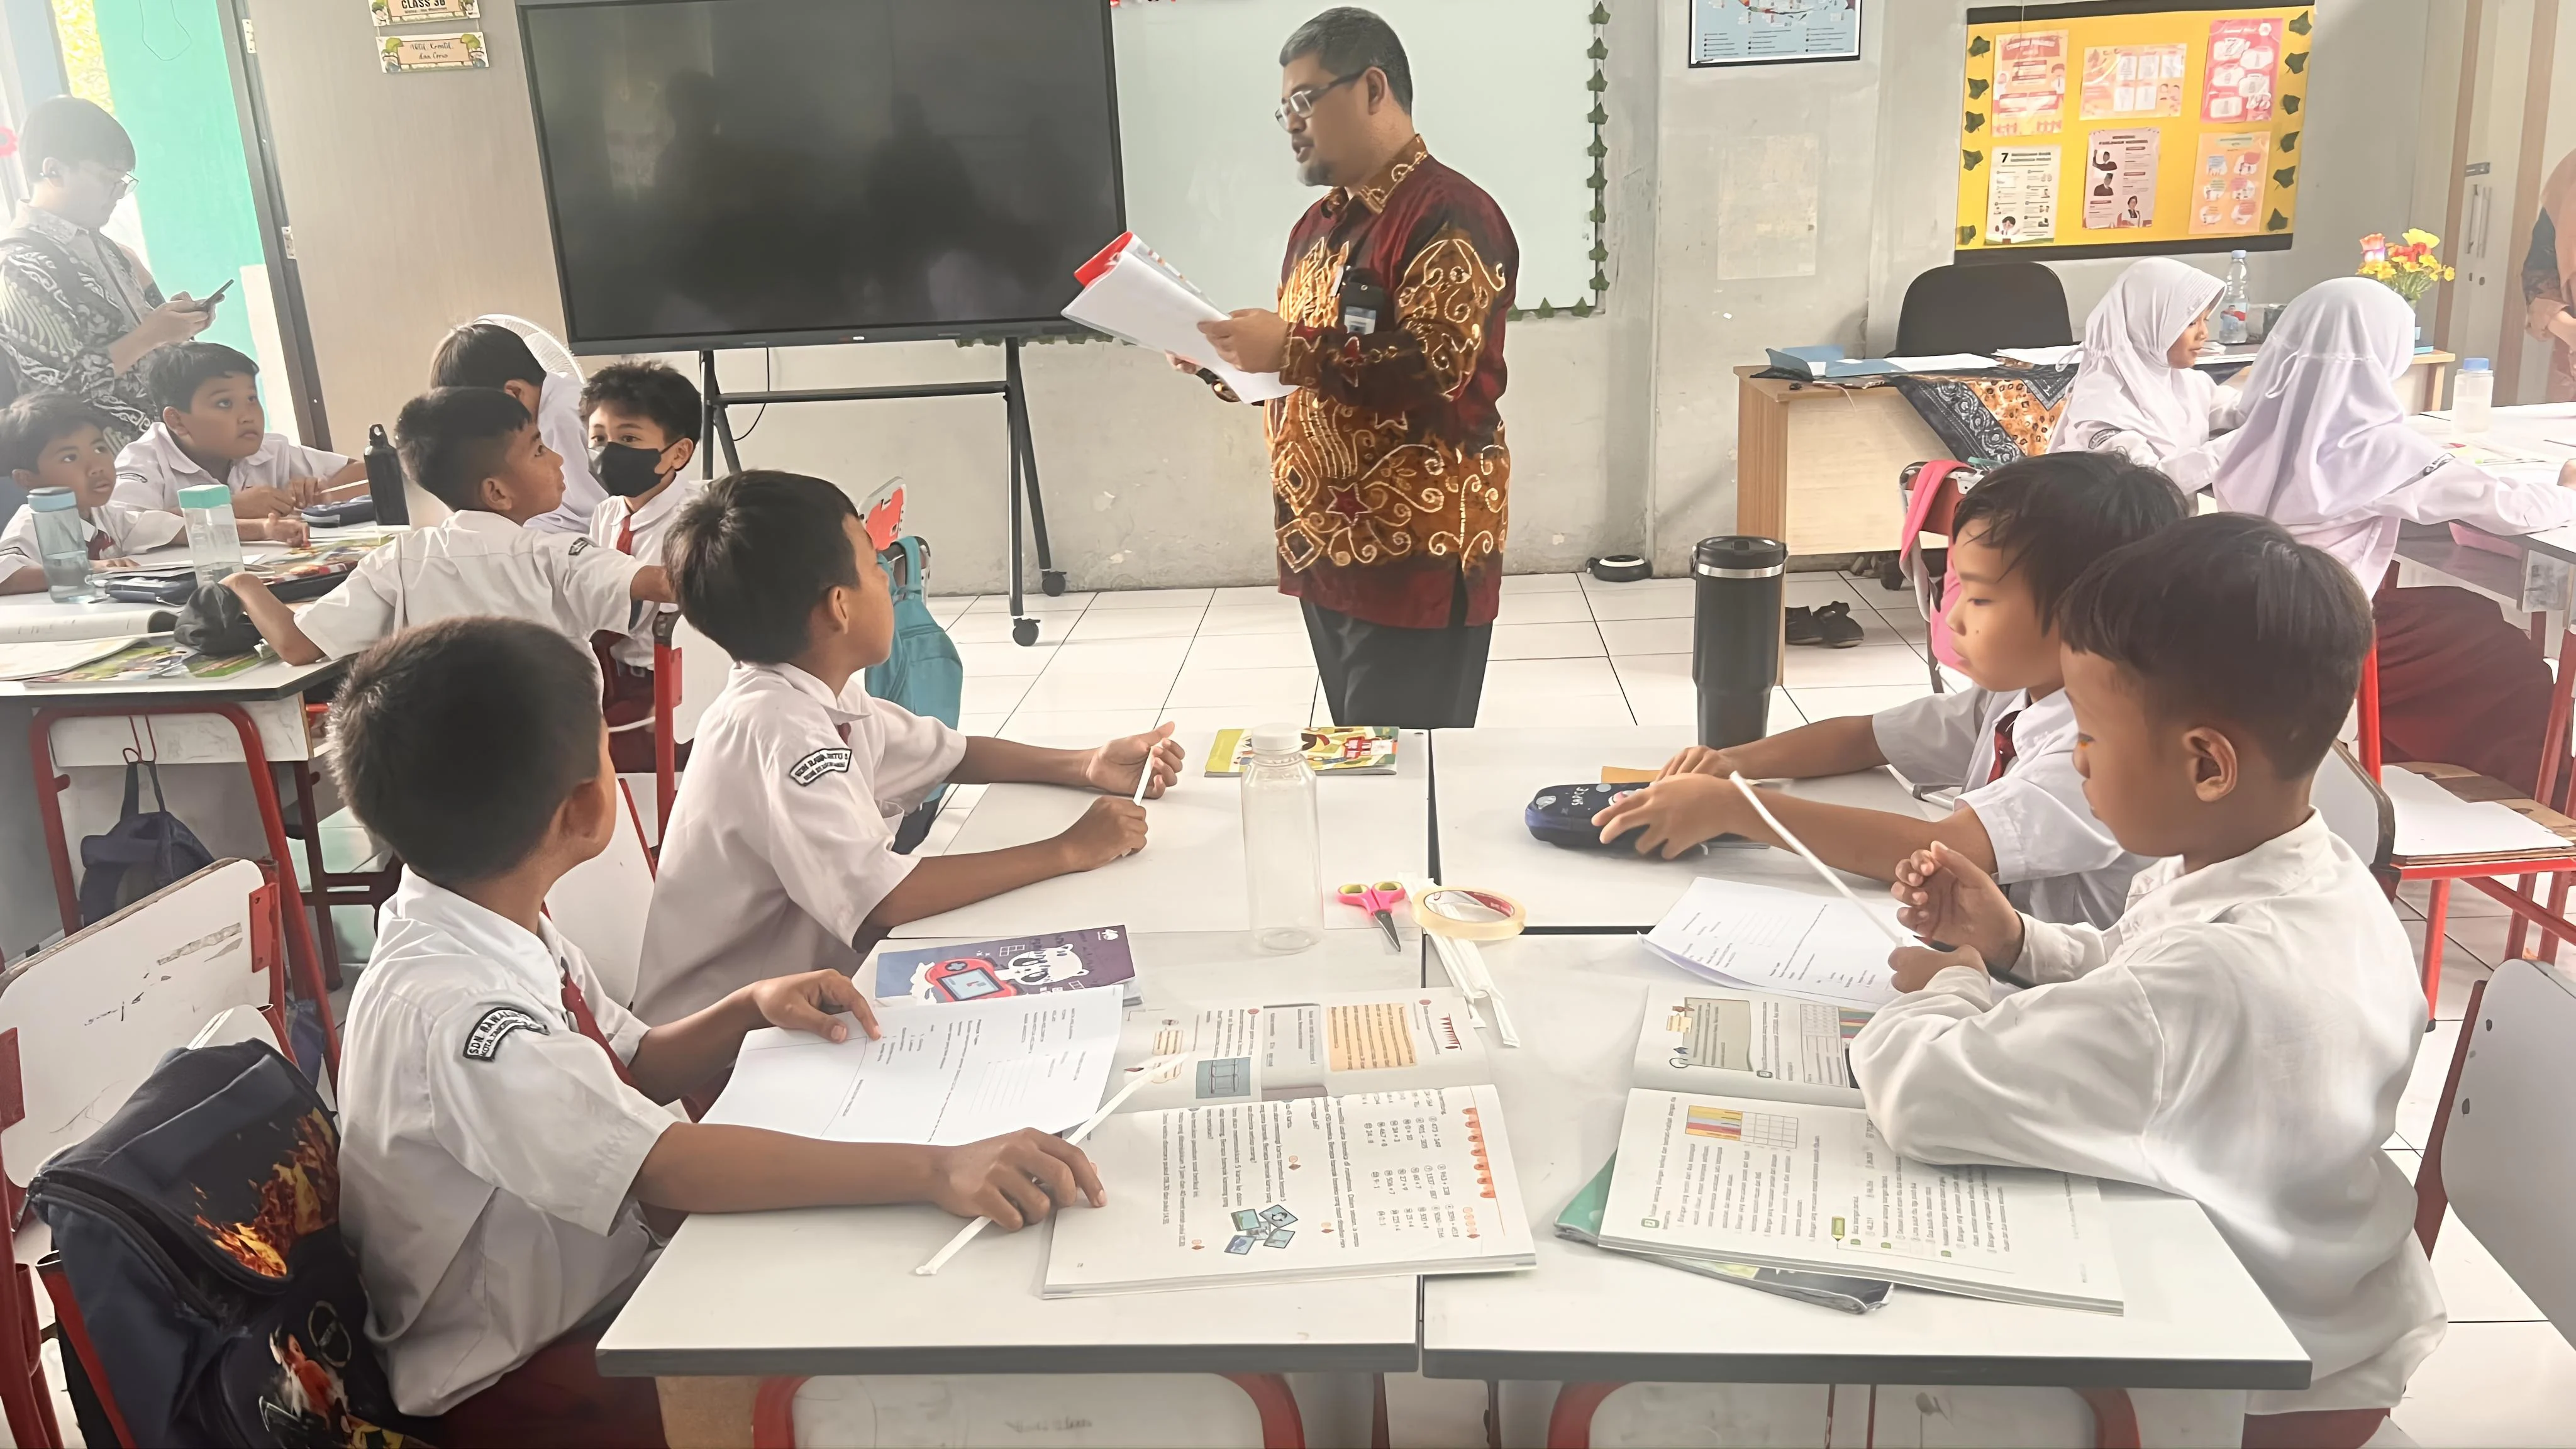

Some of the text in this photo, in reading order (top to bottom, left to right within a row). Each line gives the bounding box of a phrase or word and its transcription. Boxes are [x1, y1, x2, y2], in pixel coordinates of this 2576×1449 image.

[401, 0, 430, 9] CLASS
[2001, 153, 2009, 163] 7
[469, 1035, 484, 1054] SDN
